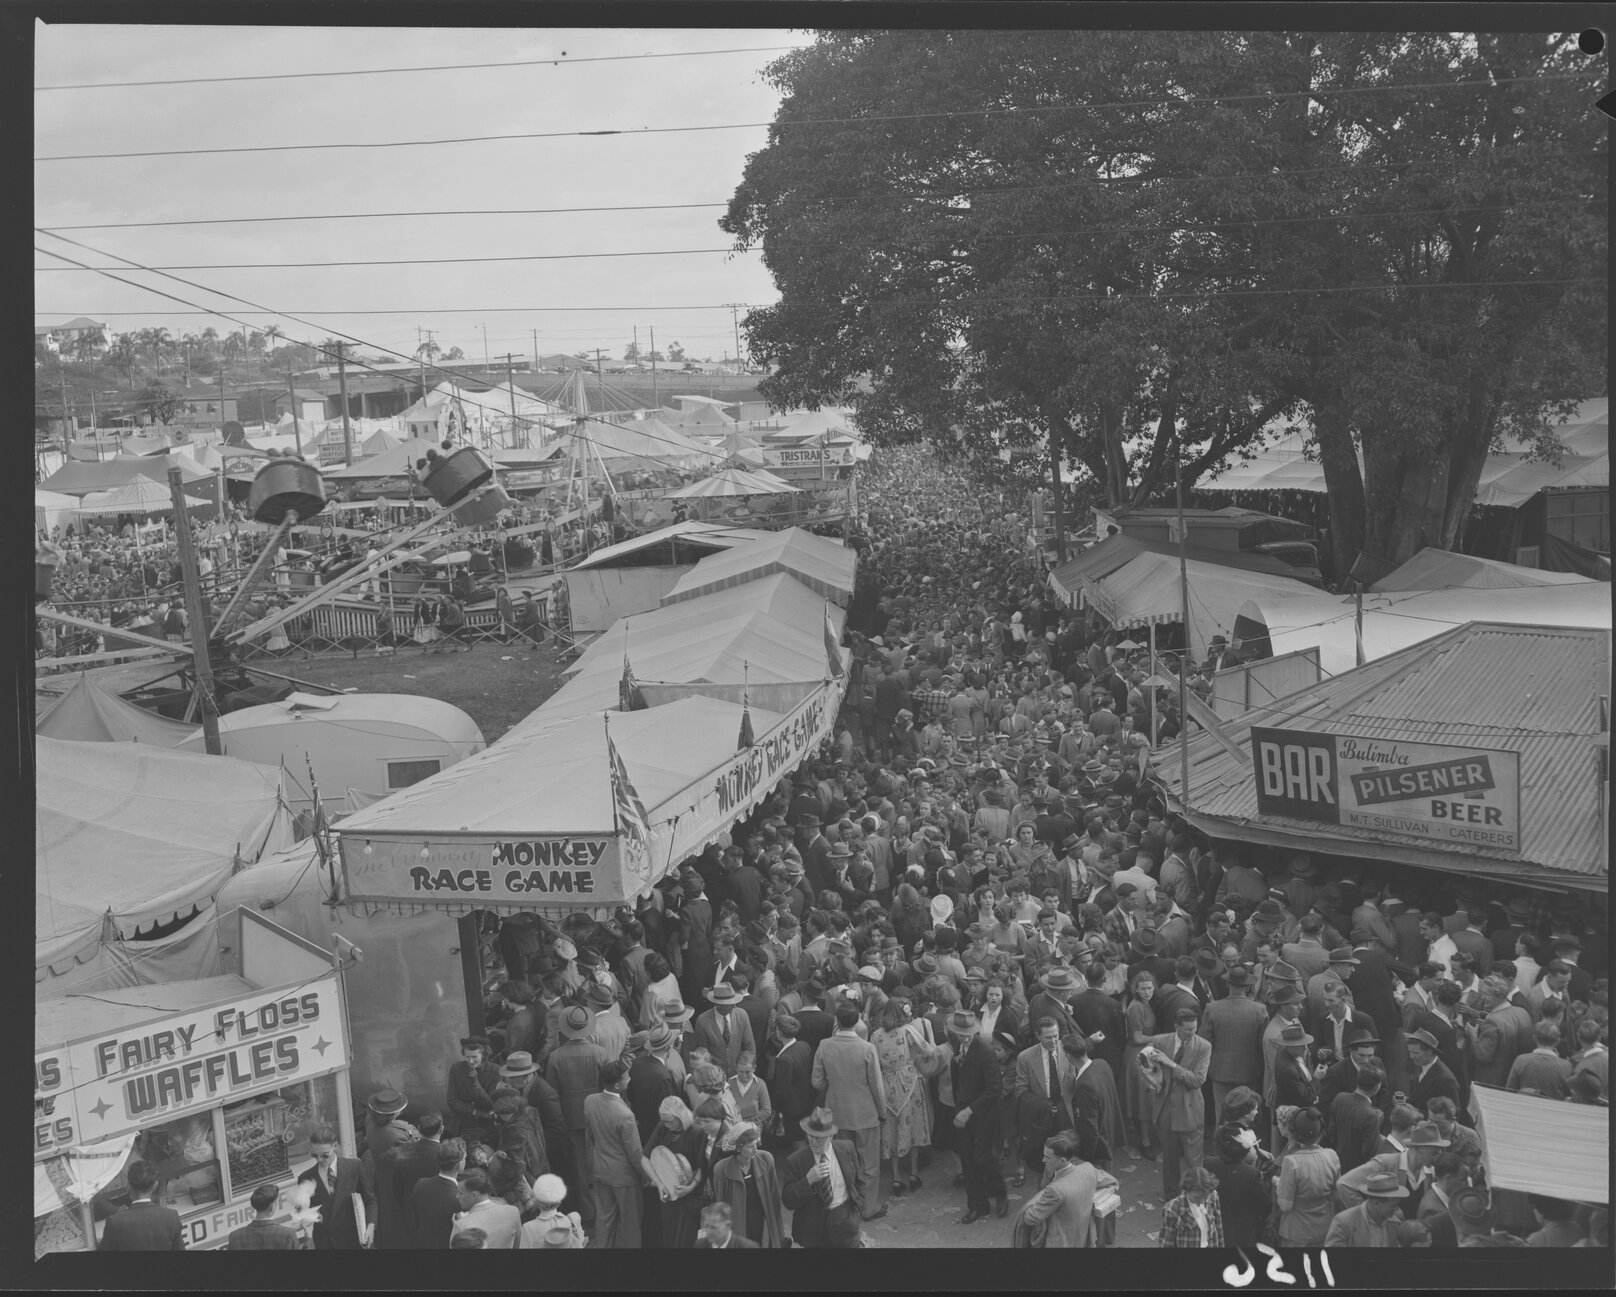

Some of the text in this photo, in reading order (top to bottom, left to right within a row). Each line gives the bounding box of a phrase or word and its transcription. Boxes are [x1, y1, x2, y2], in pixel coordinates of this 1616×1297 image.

[458, 532, 489, 541] EXIT
[716, 748, 763, 816] MONKEY
[794, 700, 819, 751] GAME
[1339, 739, 1410, 766] Bulimba
[1260, 741, 1335, 804] BAR
[1359, 763, 1486, 799] PILSENER
[1431, 800, 1503, 826] BEER
[1374, 817, 1430, 834] SULLIVAN
[1449, 827, 1513, 846] CATERERS
[492, 841, 607, 867] MONKEY
[409, 867, 595, 894] RACE GAME
[96, 992, 320, 1079] FAIRY FLOSS
[124, 1035, 300, 1120] WAFFLES
[212, 1207, 257, 1233] FAIR
